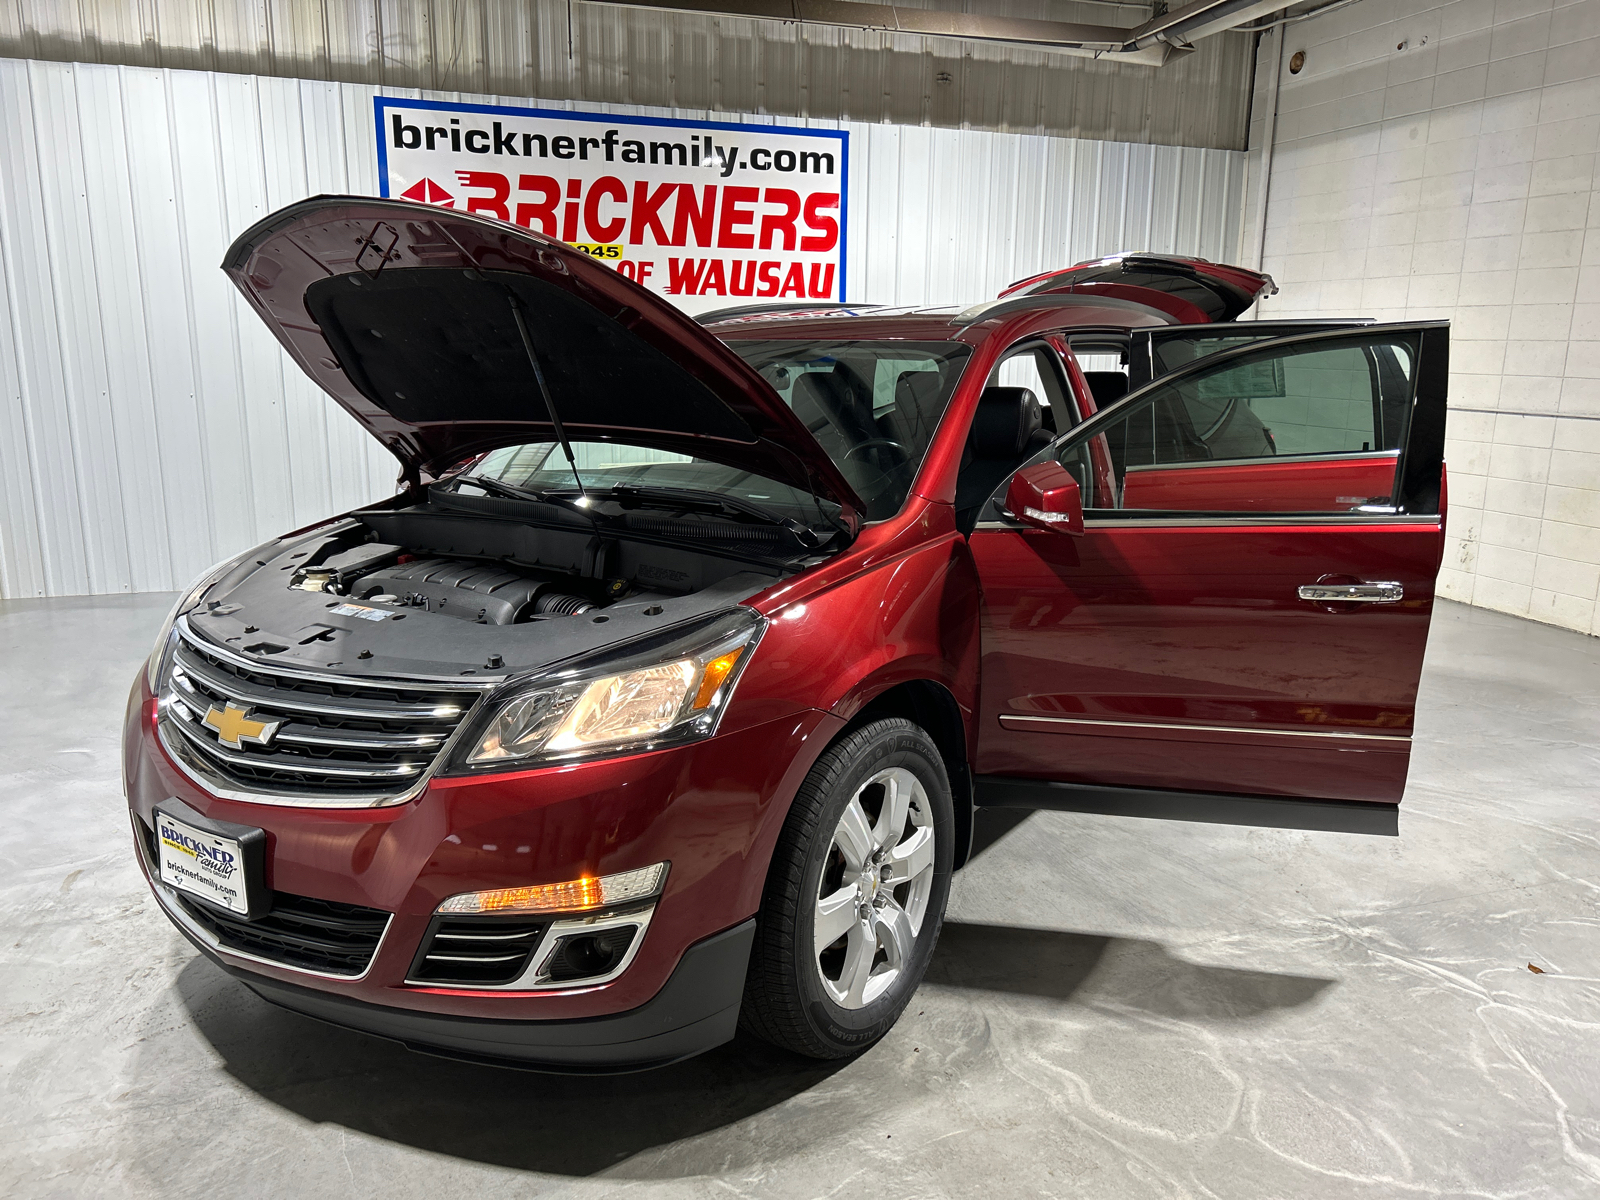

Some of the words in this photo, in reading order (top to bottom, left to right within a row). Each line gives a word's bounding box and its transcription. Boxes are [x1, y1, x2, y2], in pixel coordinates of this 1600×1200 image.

[392, 114, 834, 178] bricknerfamily.com
[571, 244, 620, 258] 945
[662, 257, 836, 299] WAUSAU
[161, 825, 235, 869] BRICKNER
[195, 851, 238, 880] Family
[167, 859, 238, 898] bricknerfamily.com
